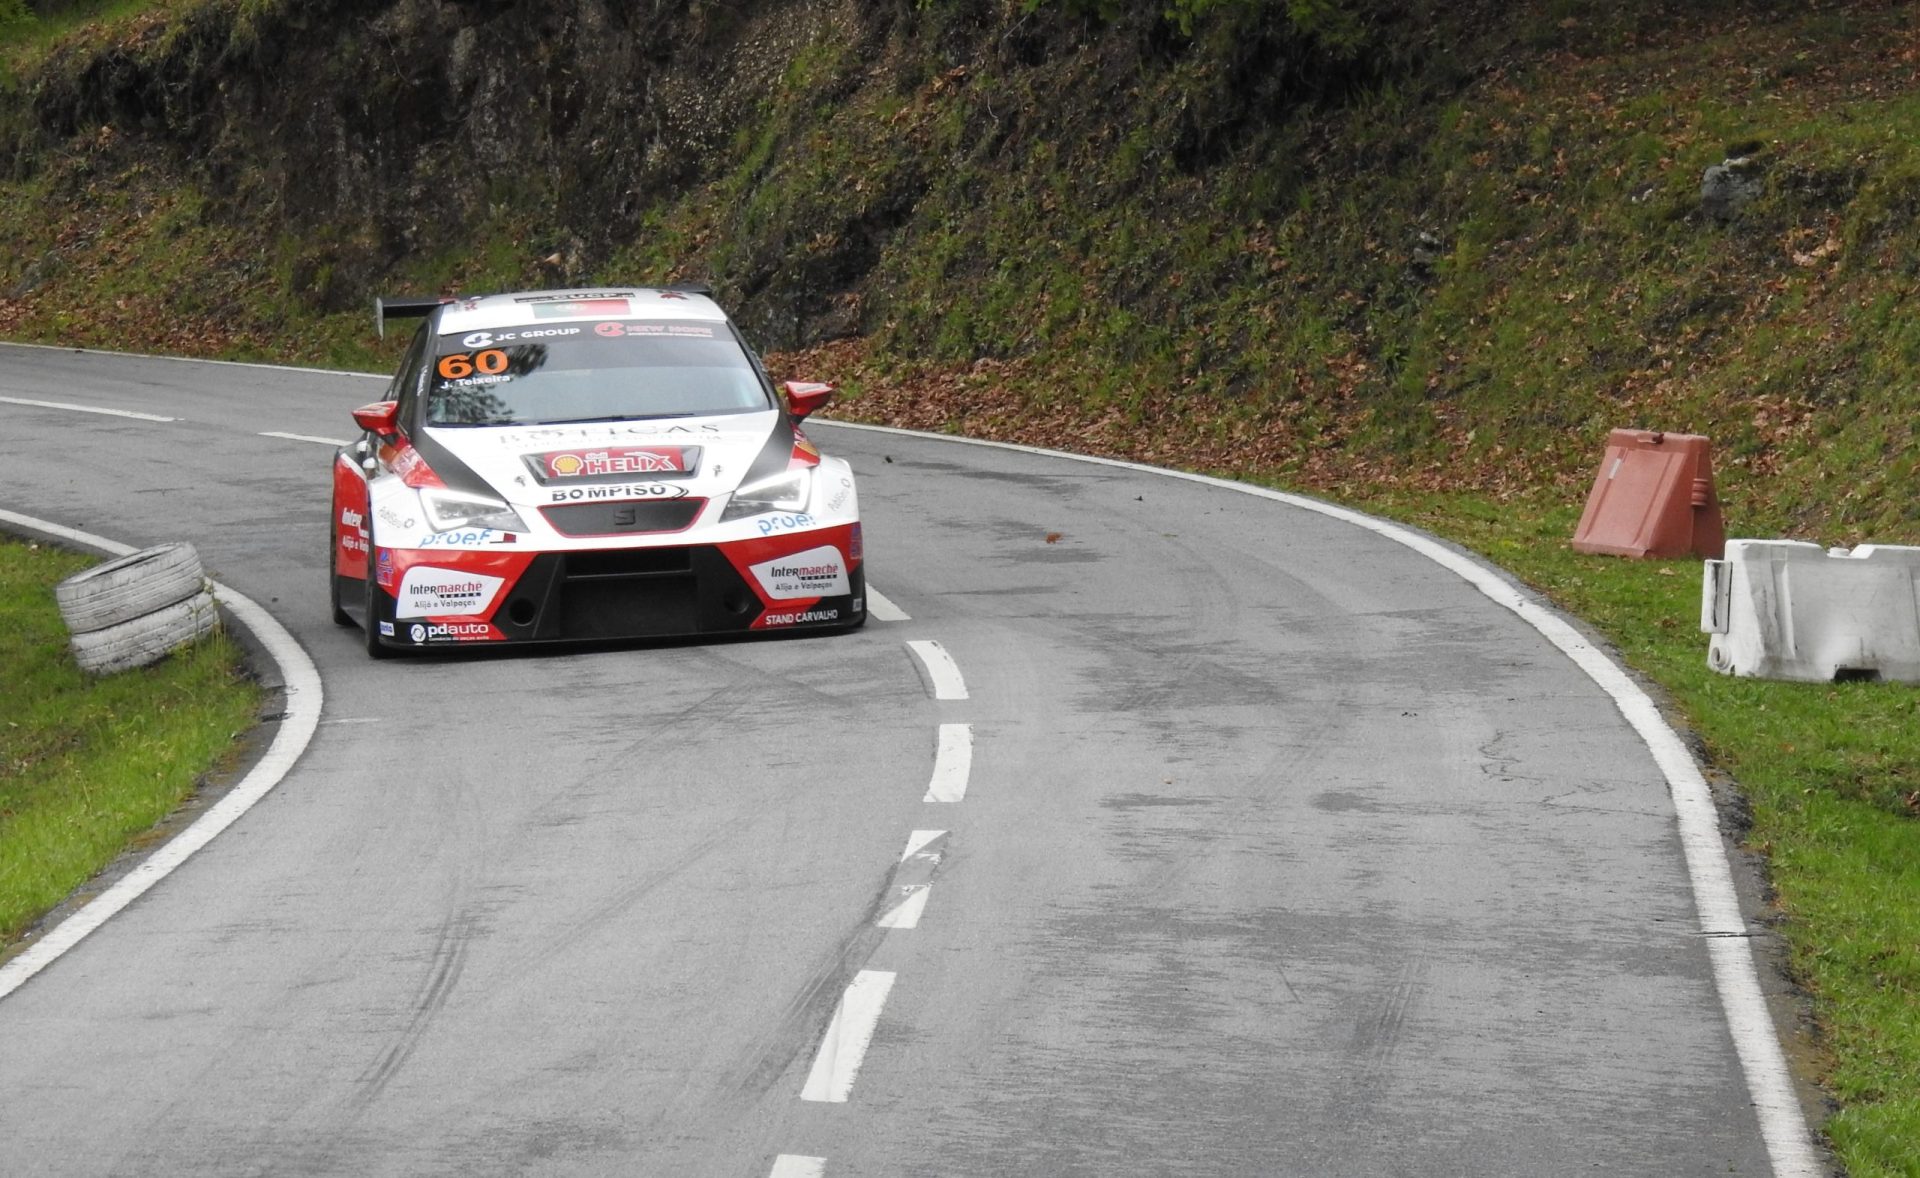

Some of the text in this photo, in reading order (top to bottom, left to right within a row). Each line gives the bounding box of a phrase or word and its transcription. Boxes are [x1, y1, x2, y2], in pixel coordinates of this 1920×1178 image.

[496, 328, 581, 341] JC GROUP
[438, 349, 509, 379] 60
[440, 375, 511, 389] J. Teixeira
[585, 454, 678, 475] HELIX
[552, 485, 667, 501] BOMPISO
[765, 609, 838, 625] STAND CARVALHO
[427, 623, 489, 637] pdauto
